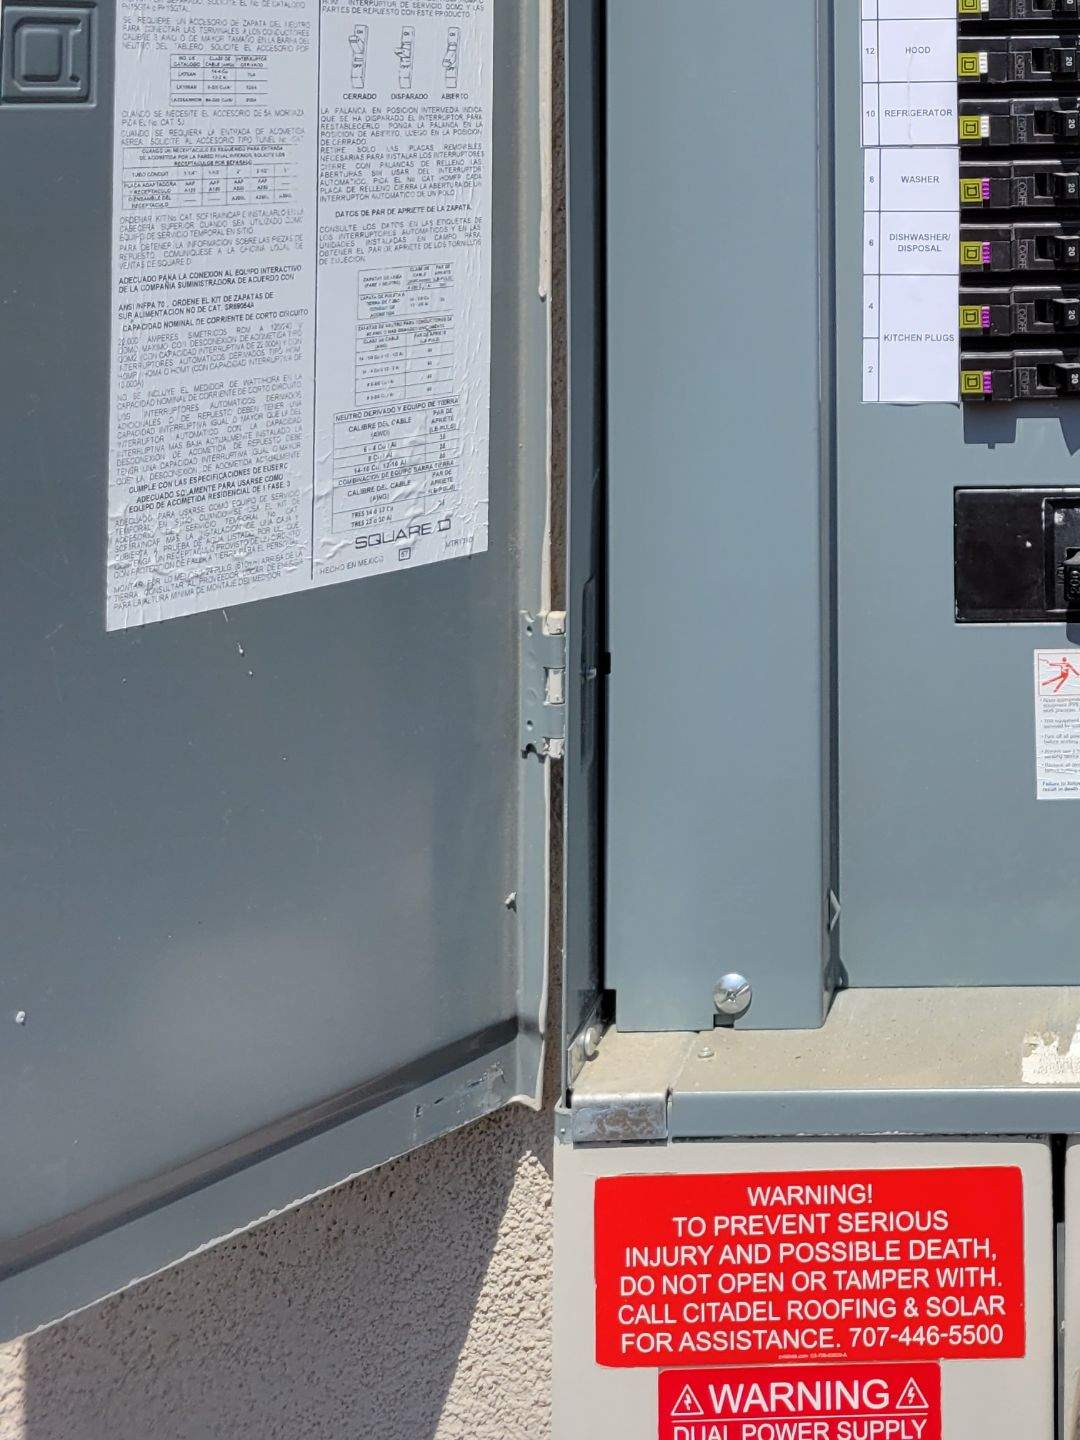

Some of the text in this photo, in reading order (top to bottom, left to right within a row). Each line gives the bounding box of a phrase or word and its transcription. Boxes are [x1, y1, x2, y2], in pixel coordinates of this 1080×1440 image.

[885, 109, 952, 117] REFRIGERATOR
[884, 334, 955, 342] KITCHEN PLUGS
[355, 519, 451, 549] SQUARE D
[748, 1184, 873, 1206] WARNING!
[672, 1210, 948, 1238] TO PREVENT SERIOUS
[625, 1238, 997, 1268] INJURY AND POSSIBLE DEATH,
[621, 1267, 1002, 1297] DO NOT OPEN OR TAMPER WITH.
[618, 1295, 1005, 1325] CALL CITADEL ROOFING & SOLAR
[622, 1324, 1003, 1353] FOR ASSISTANCE. 707-446-5500
[708, 1378, 889, 1414] WARNING
[674, 1419, 927, 1440] DUAL POWER SUPPLY
